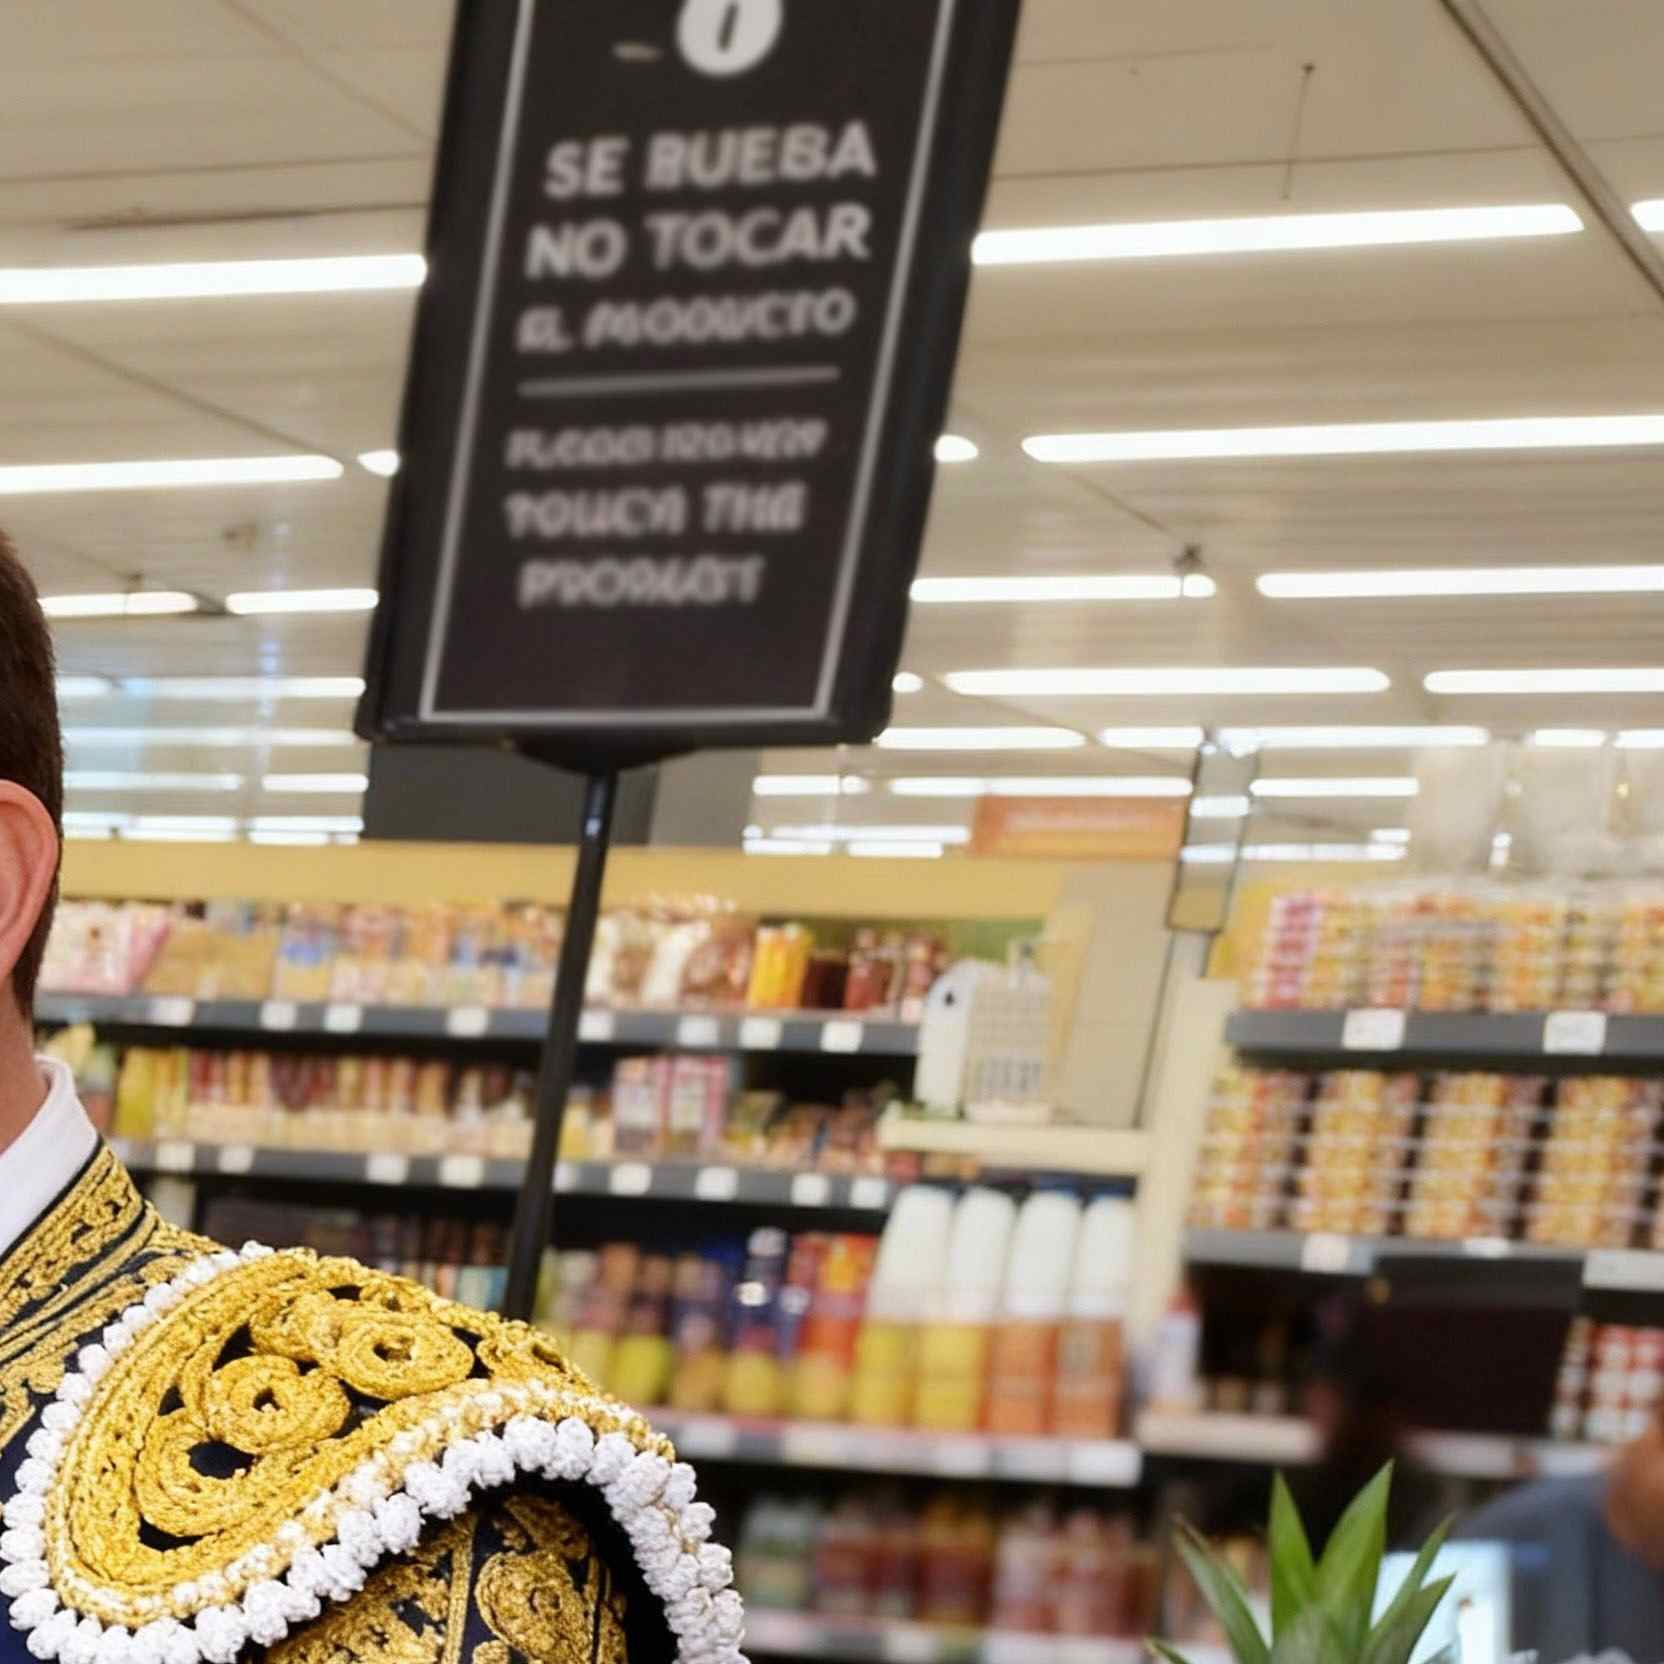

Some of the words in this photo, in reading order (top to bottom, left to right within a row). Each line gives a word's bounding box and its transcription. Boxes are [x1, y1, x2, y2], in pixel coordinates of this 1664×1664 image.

[545, 139, 626, 197] SE
[526, 220, 625, 278] NO
[644, 204, 870, 269] TOCAR
